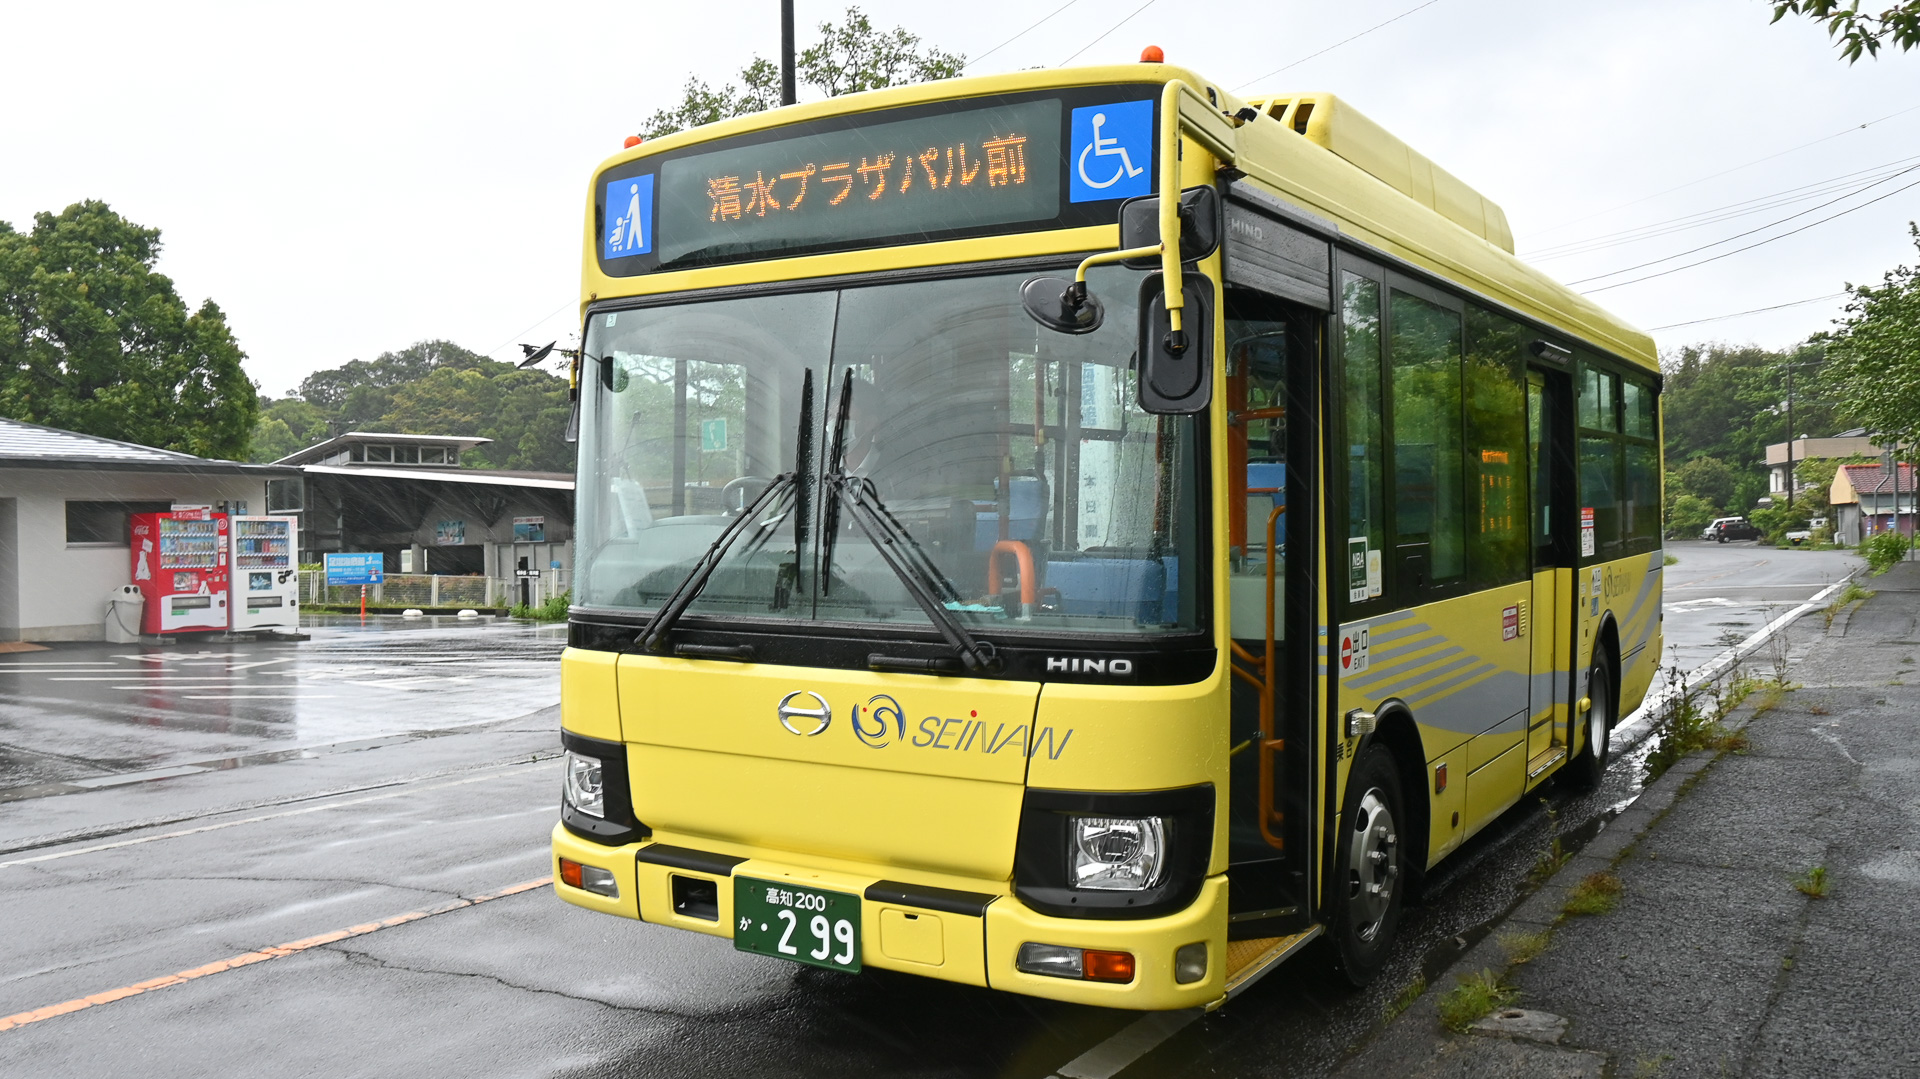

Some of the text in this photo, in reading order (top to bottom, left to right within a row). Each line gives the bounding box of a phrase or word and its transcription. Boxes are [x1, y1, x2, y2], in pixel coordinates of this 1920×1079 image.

[706, 133, 1028, 222] 清水プラザパル前
[1231, 217, 1263, 241] HINO
[1352, 551, 1365, 568] NBA
[1352, 629, 1368, 654] 出口
[1046, 657, 1132, 675] HINO
[1354, 655, 1366, 670] EXIT
[911, 709, 1074, 760] SEINAN
[766, 887, 826, 912] 高知 200
